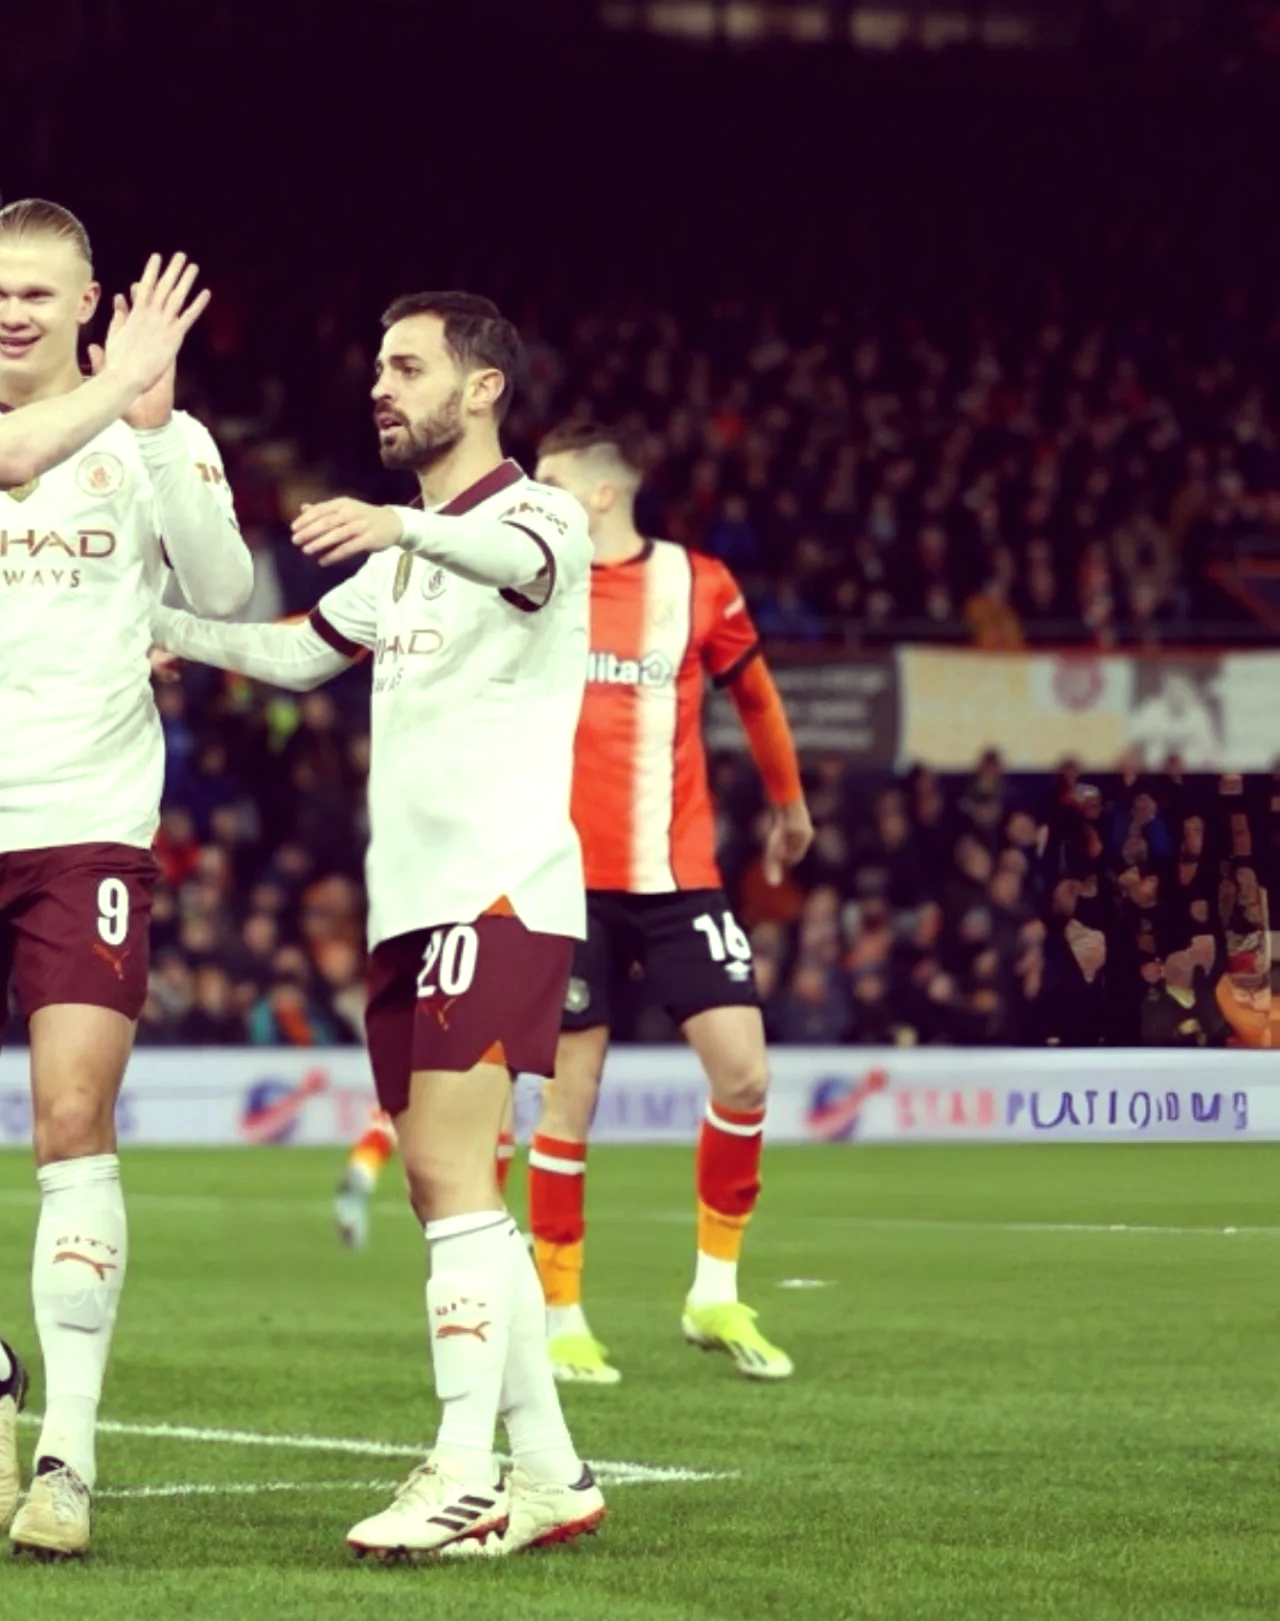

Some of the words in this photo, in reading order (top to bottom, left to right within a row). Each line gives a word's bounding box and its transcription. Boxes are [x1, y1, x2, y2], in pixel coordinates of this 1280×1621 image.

[97, 878, 129, 945] 9
[693, 911, 751, 961] 16
[416, 924, 478, 998] 20
